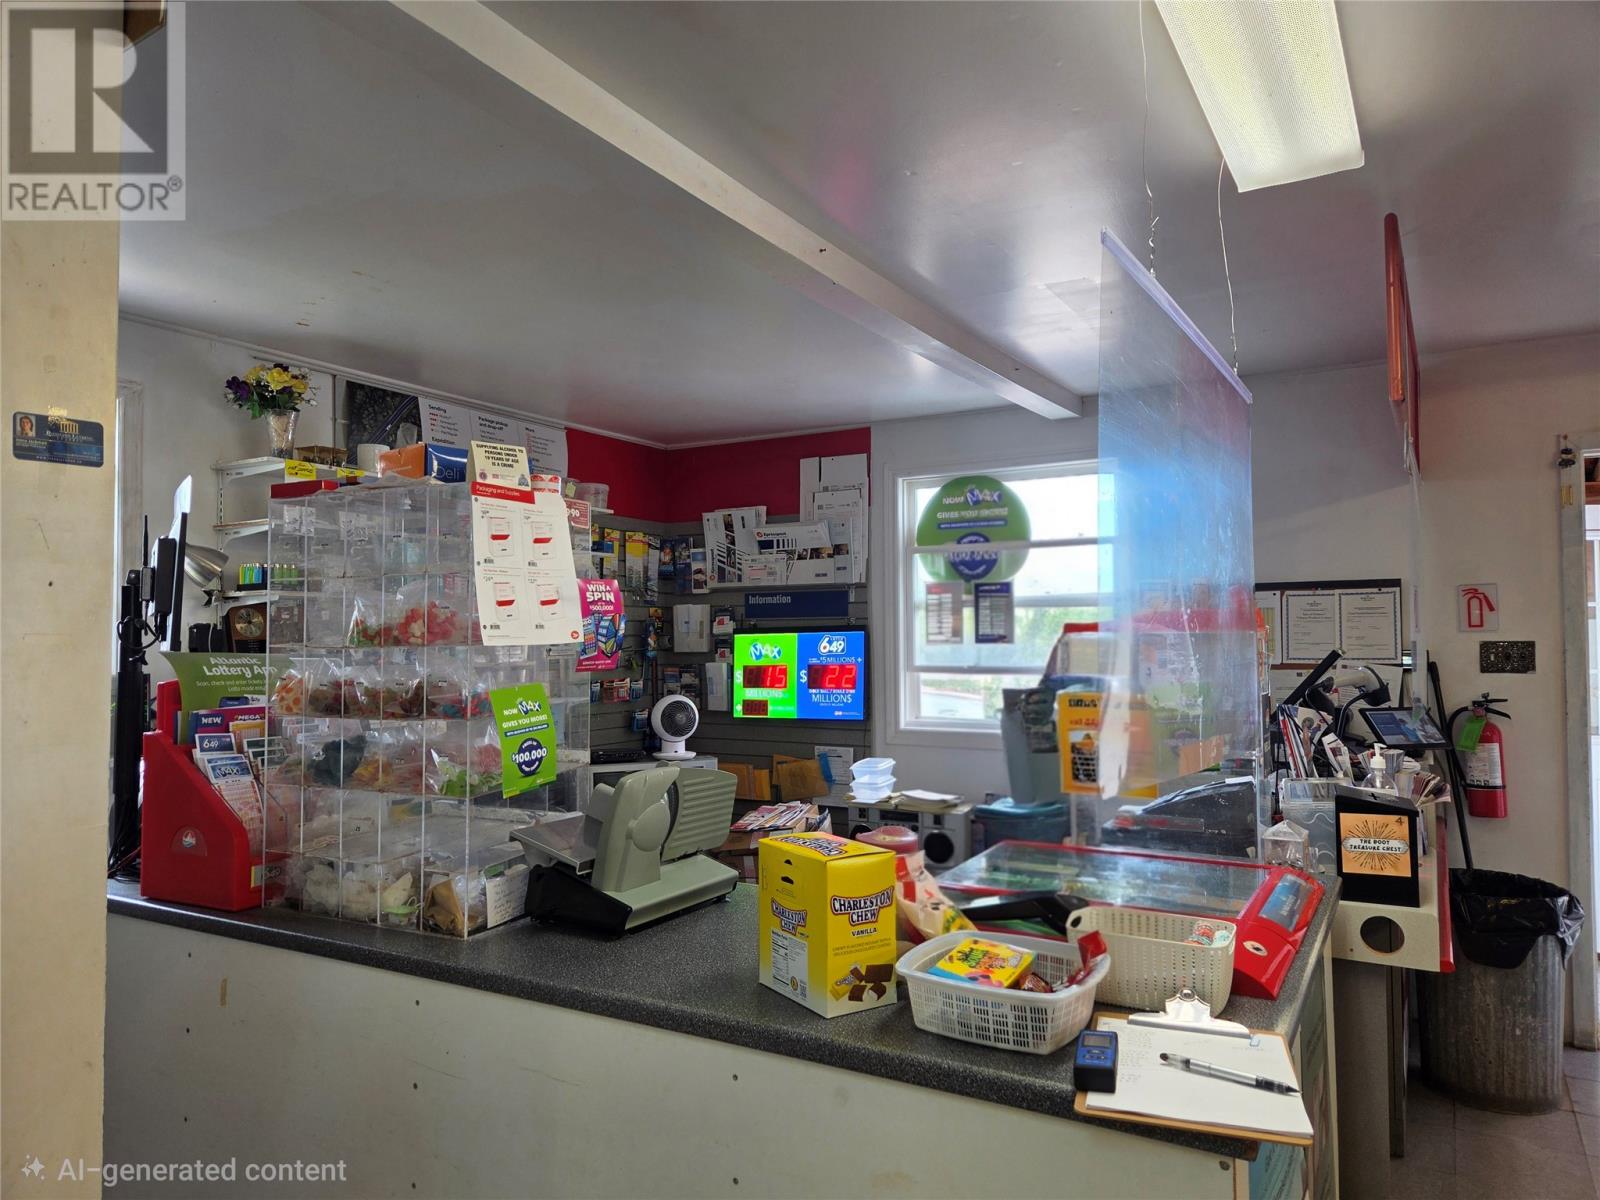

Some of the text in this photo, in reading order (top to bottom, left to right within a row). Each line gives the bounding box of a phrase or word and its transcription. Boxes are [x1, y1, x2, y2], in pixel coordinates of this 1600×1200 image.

[428, 404, 447, 413] Sending
[476, 484, 497, 494] Packaging
[586, 584, 606, 592] WIN
[585, 591, 615, 603] SPIN
[748, 594, 791, 604] Information
[203, 665, 252, 678] Lottery
[799, 665, 857, 688] $ 22
[201, 716, 222, 724] NEW
[502, 714, 548, 729] GIVES YOU MORE!
[512, 747, 547, 763] $100,000
[833, 888, 893, 912] CHARLESTON
[772, 899, 806, 923] CHARLESTON
[851, 909, 878, 924] CHEW
[781, 918, 797, 935] CHEW
[852, 928, 877, 937] VANILLA
